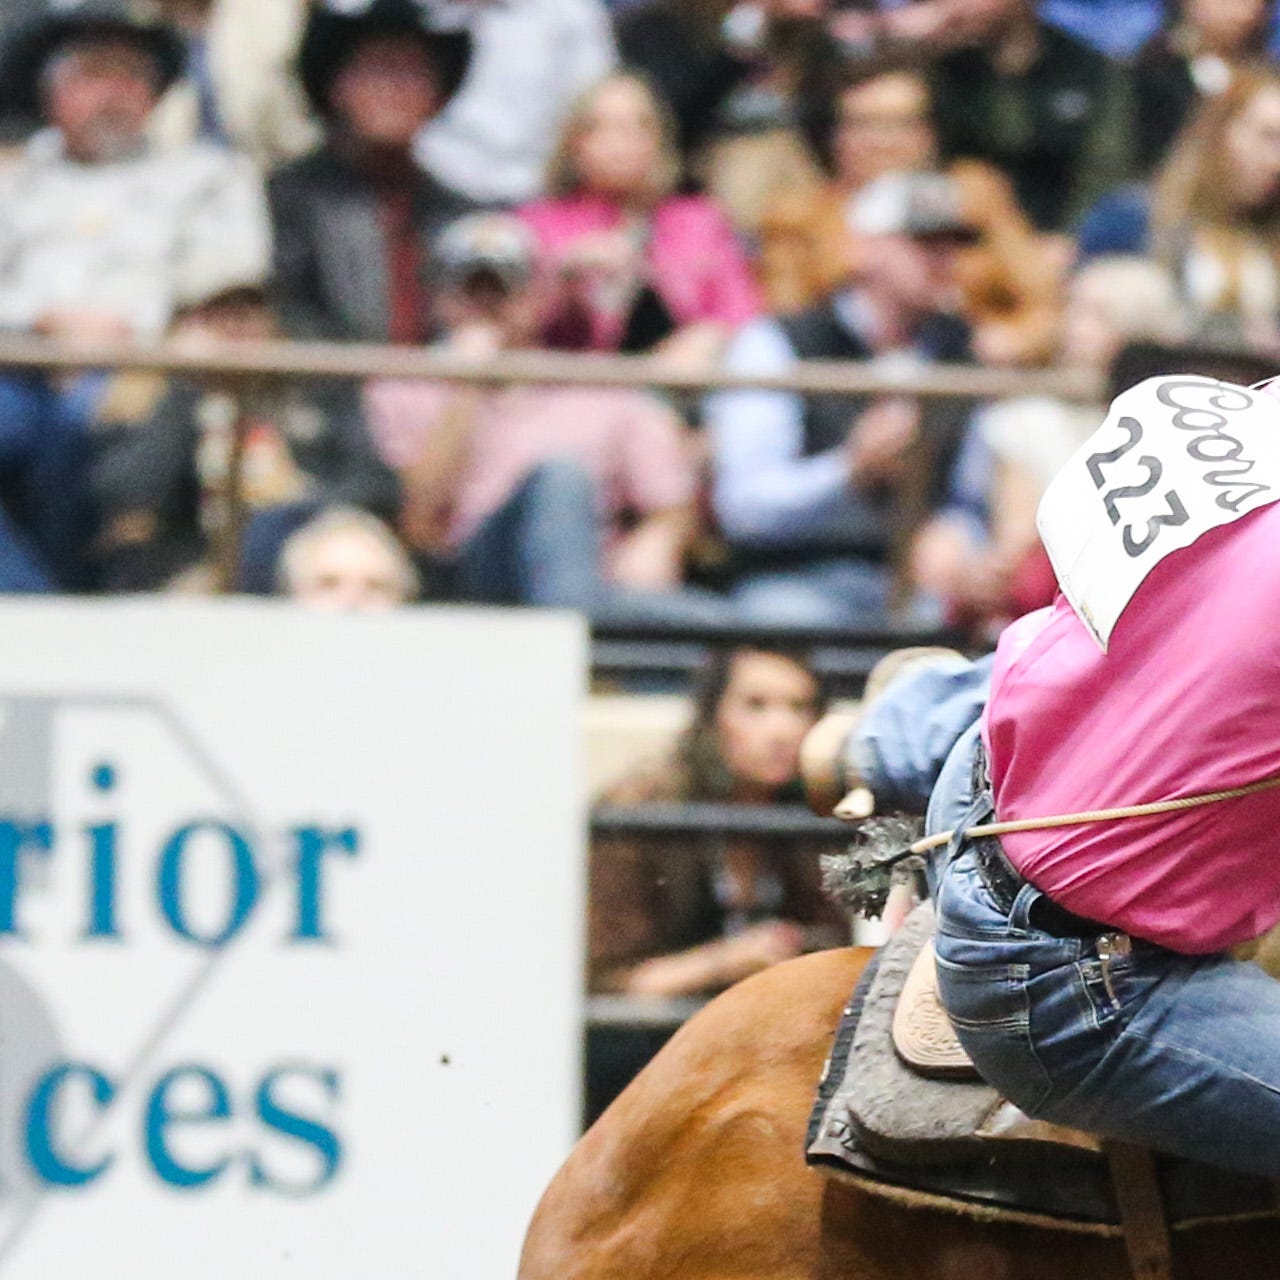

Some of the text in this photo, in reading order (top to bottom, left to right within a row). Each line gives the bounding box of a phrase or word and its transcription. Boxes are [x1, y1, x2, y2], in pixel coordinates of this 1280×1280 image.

[1085, 416, 1190, 558] 223
[1156, 380, 1271, 512] Coors
[0, 762, 362, 948] rior
[24, 1061, 345, 1195] ces
